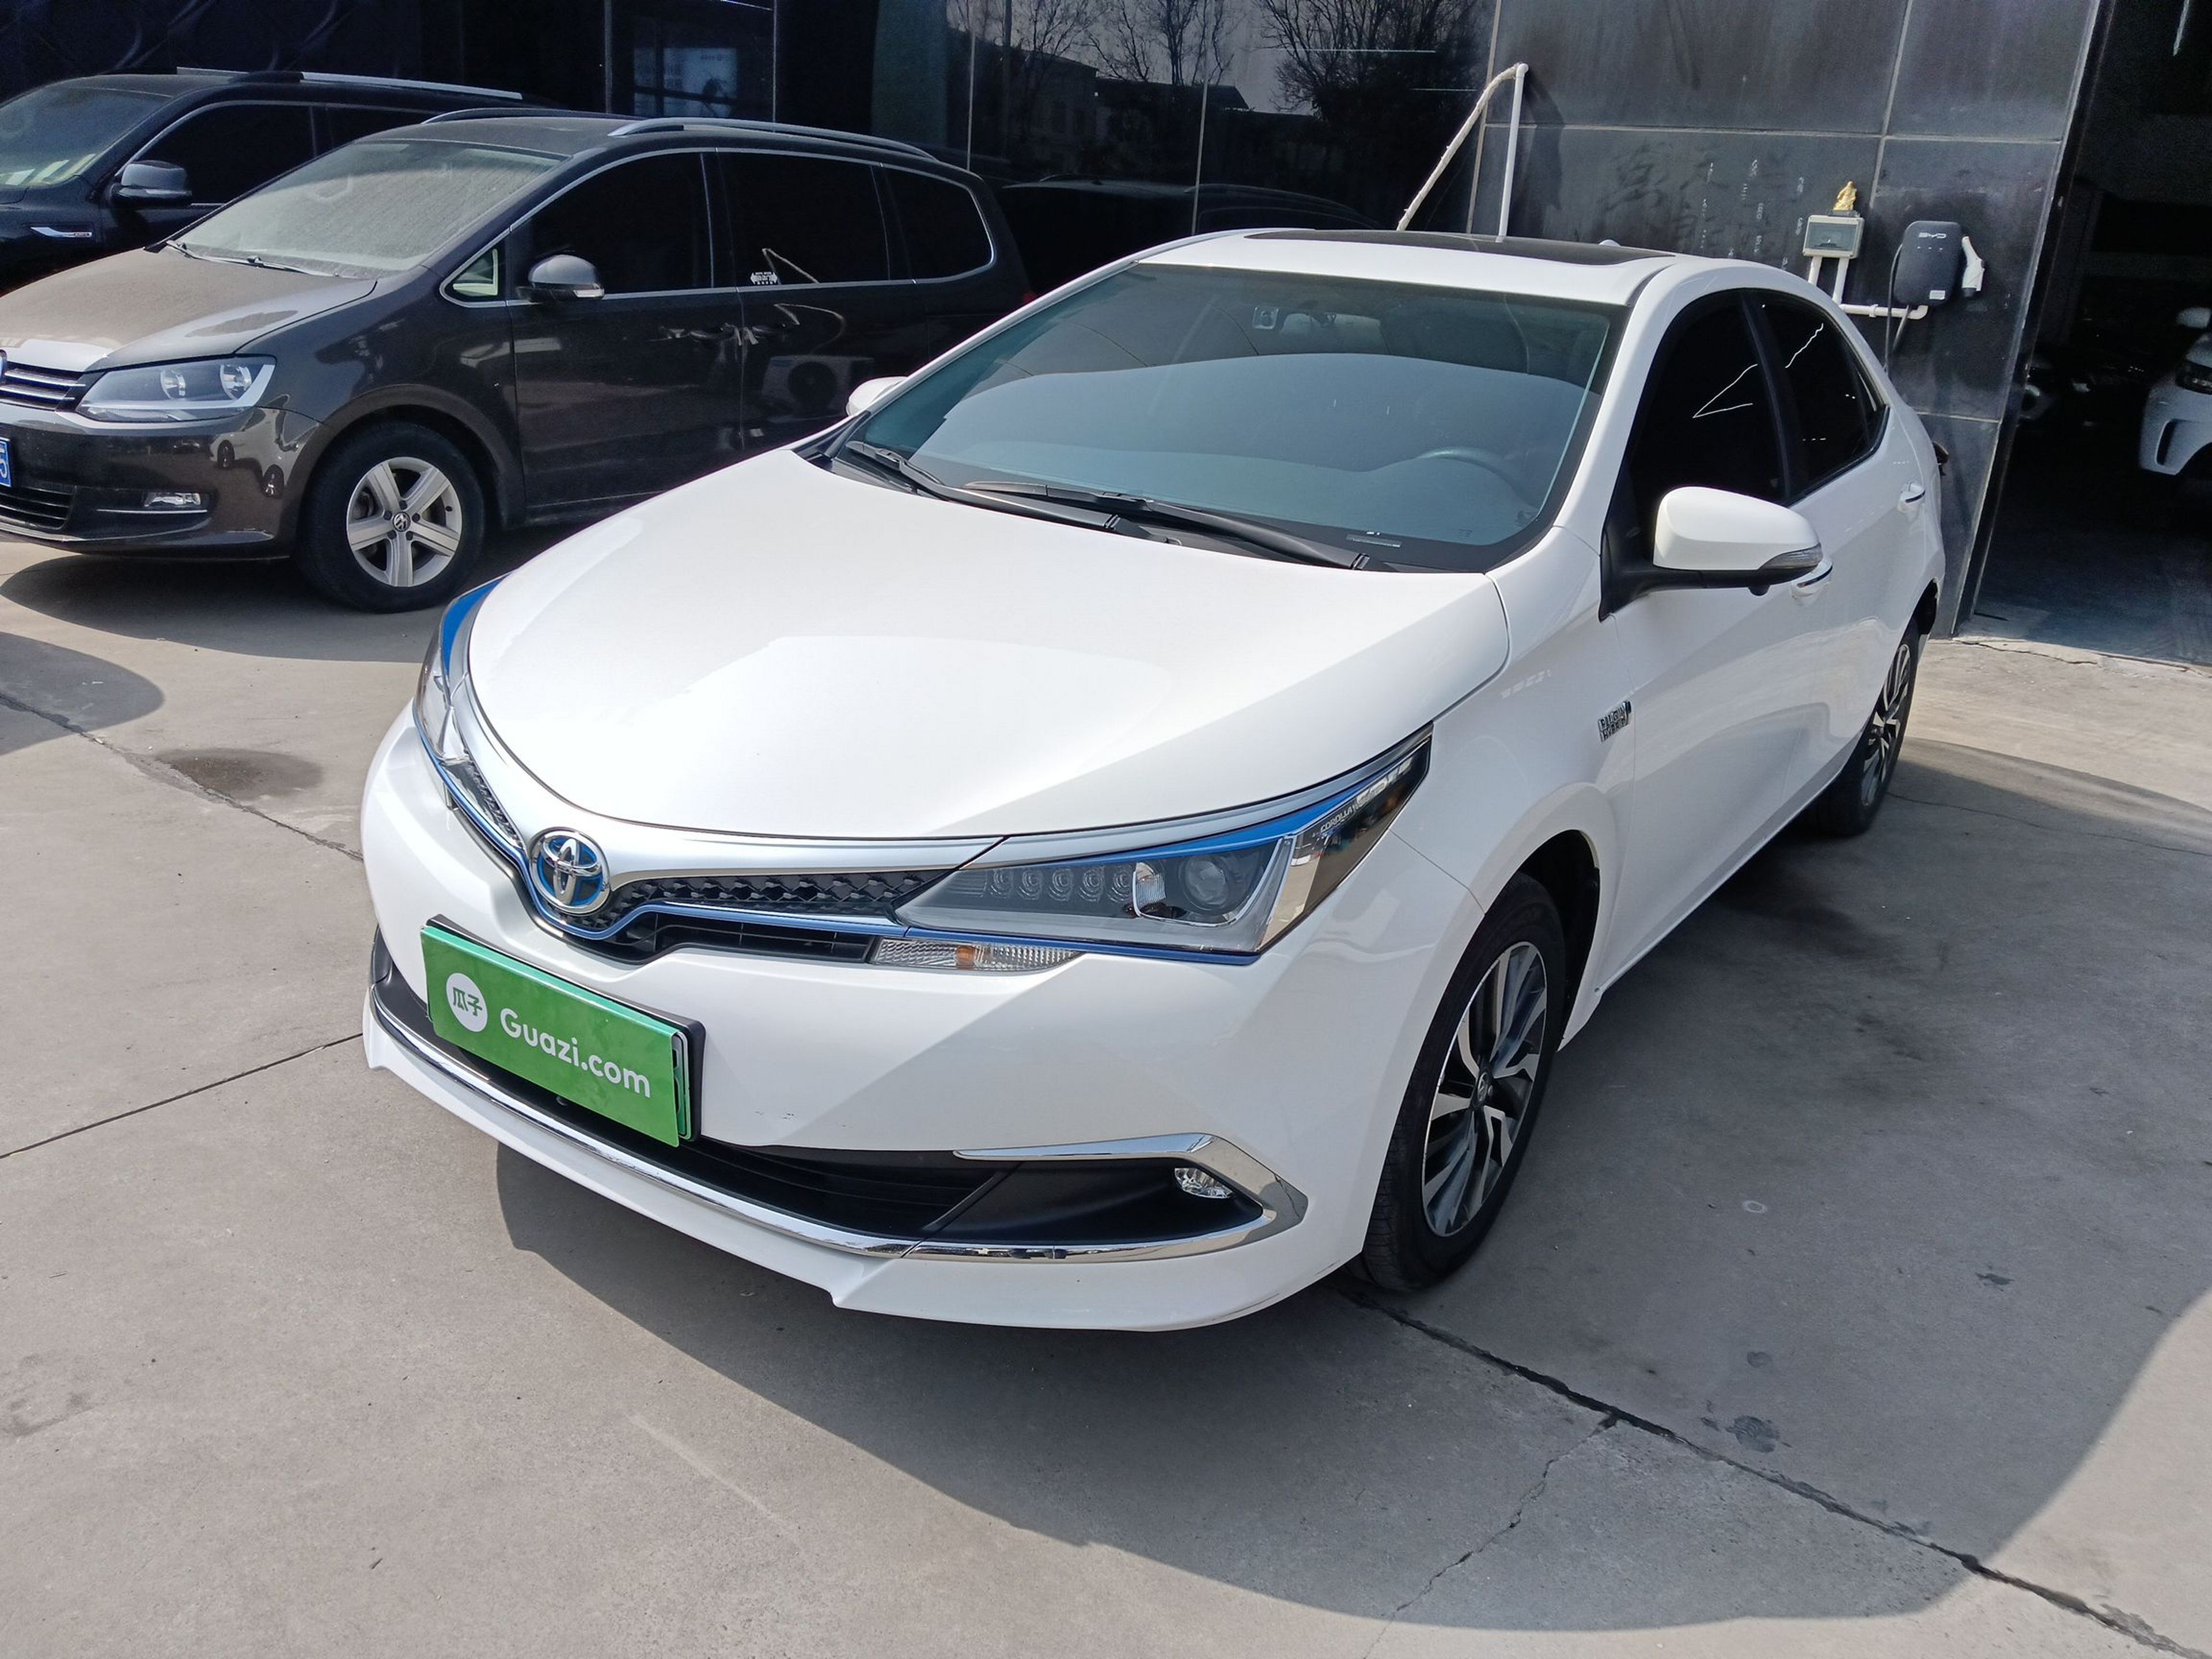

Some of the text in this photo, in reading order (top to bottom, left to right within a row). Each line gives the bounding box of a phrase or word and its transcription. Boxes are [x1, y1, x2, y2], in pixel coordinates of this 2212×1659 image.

[1320, 805, 1353, 834] COROLLA
[452, 986, 483, 1017] 瓜子
[499, 1008, 651, 1098] Guazi.com
